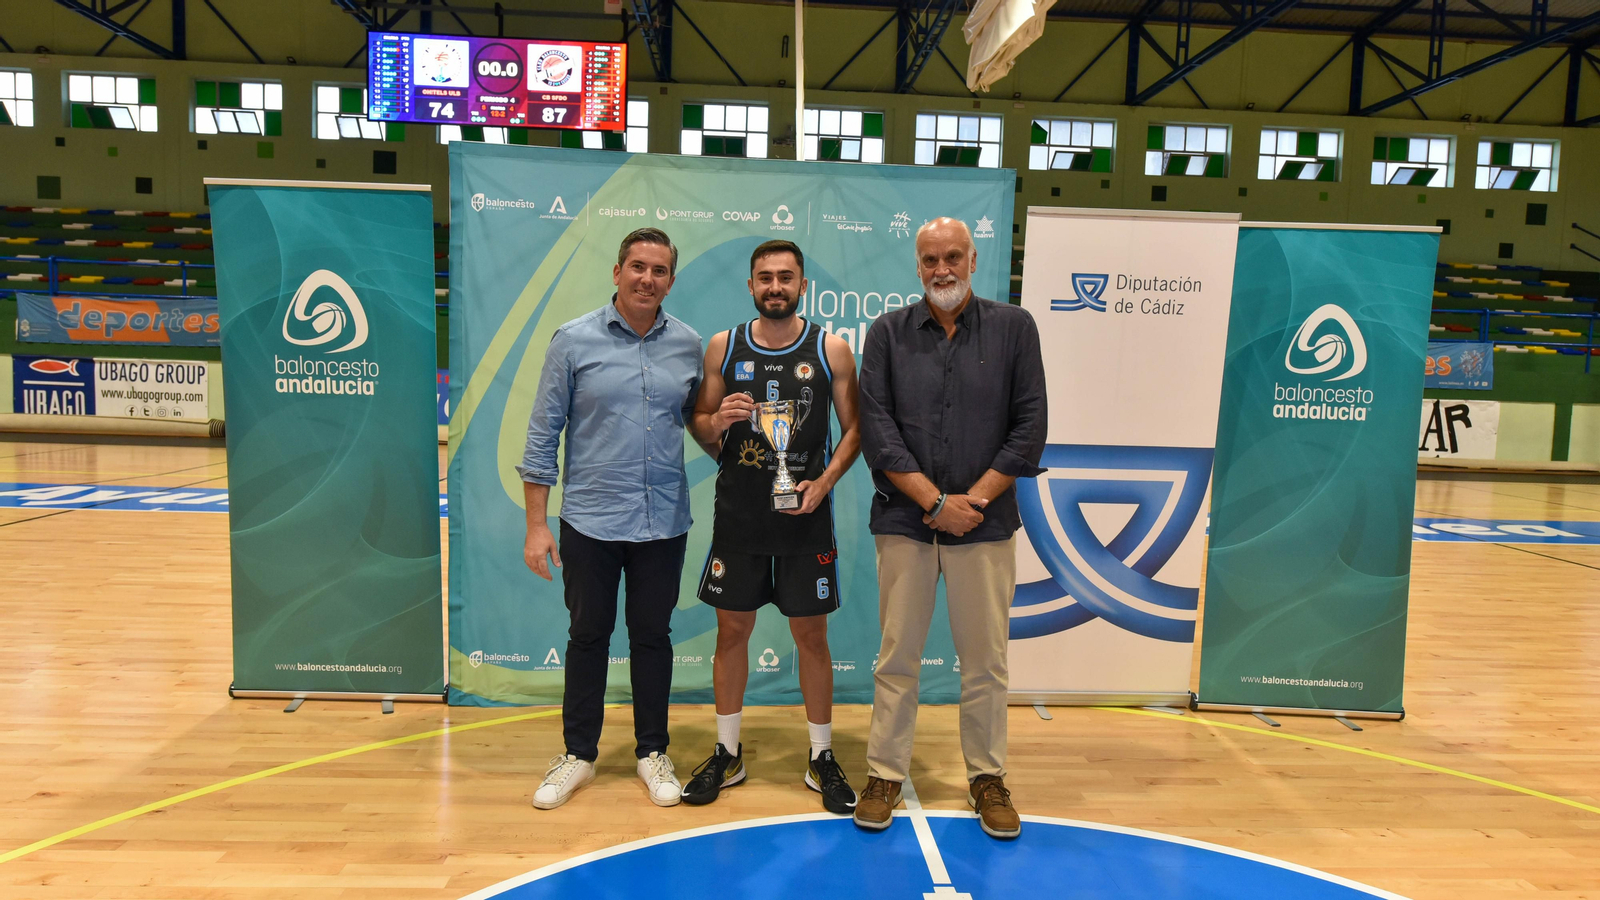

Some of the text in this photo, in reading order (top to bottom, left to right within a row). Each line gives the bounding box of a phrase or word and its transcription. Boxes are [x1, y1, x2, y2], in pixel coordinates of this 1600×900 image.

[478, 60, 519, 78] 00.0
[429, 102, 454, 118] 74
[542, 107, 568, 124] 87
[598, 207, 638, 218] cajasur
[669, 210, 714, 219] PONT GRUP
[722, 210, 761, 222] COVAP
[770, 223, 796, 232] urbaser
[890, 220, 908, 228] vive
[1116, 274, 1202, 296] Diputación
[1114, 298, 1184, 316] de Cádiz
[57, 300, 220, 338] deportes
[100, 361, 206, 385] UBAGO GROUP
[274, 354, 380, 378] baloncesto
[764, 364, 784, 372] vive
[101, 386, 204, 404] www.ubagogroup.com
[766, 379, 780, 402] 6
[1274, 382, 1374, 404] baloncesto
[0, 486, 229, 506] Ayu
[816, 577, 830, 600] 6
[484, 652, 530, 663] baloncesto
[274, 662, 402, 675] www.baloncestoandalucia.org
[1240, 676, 1364, 691] www.baloncestoandalucia.org
